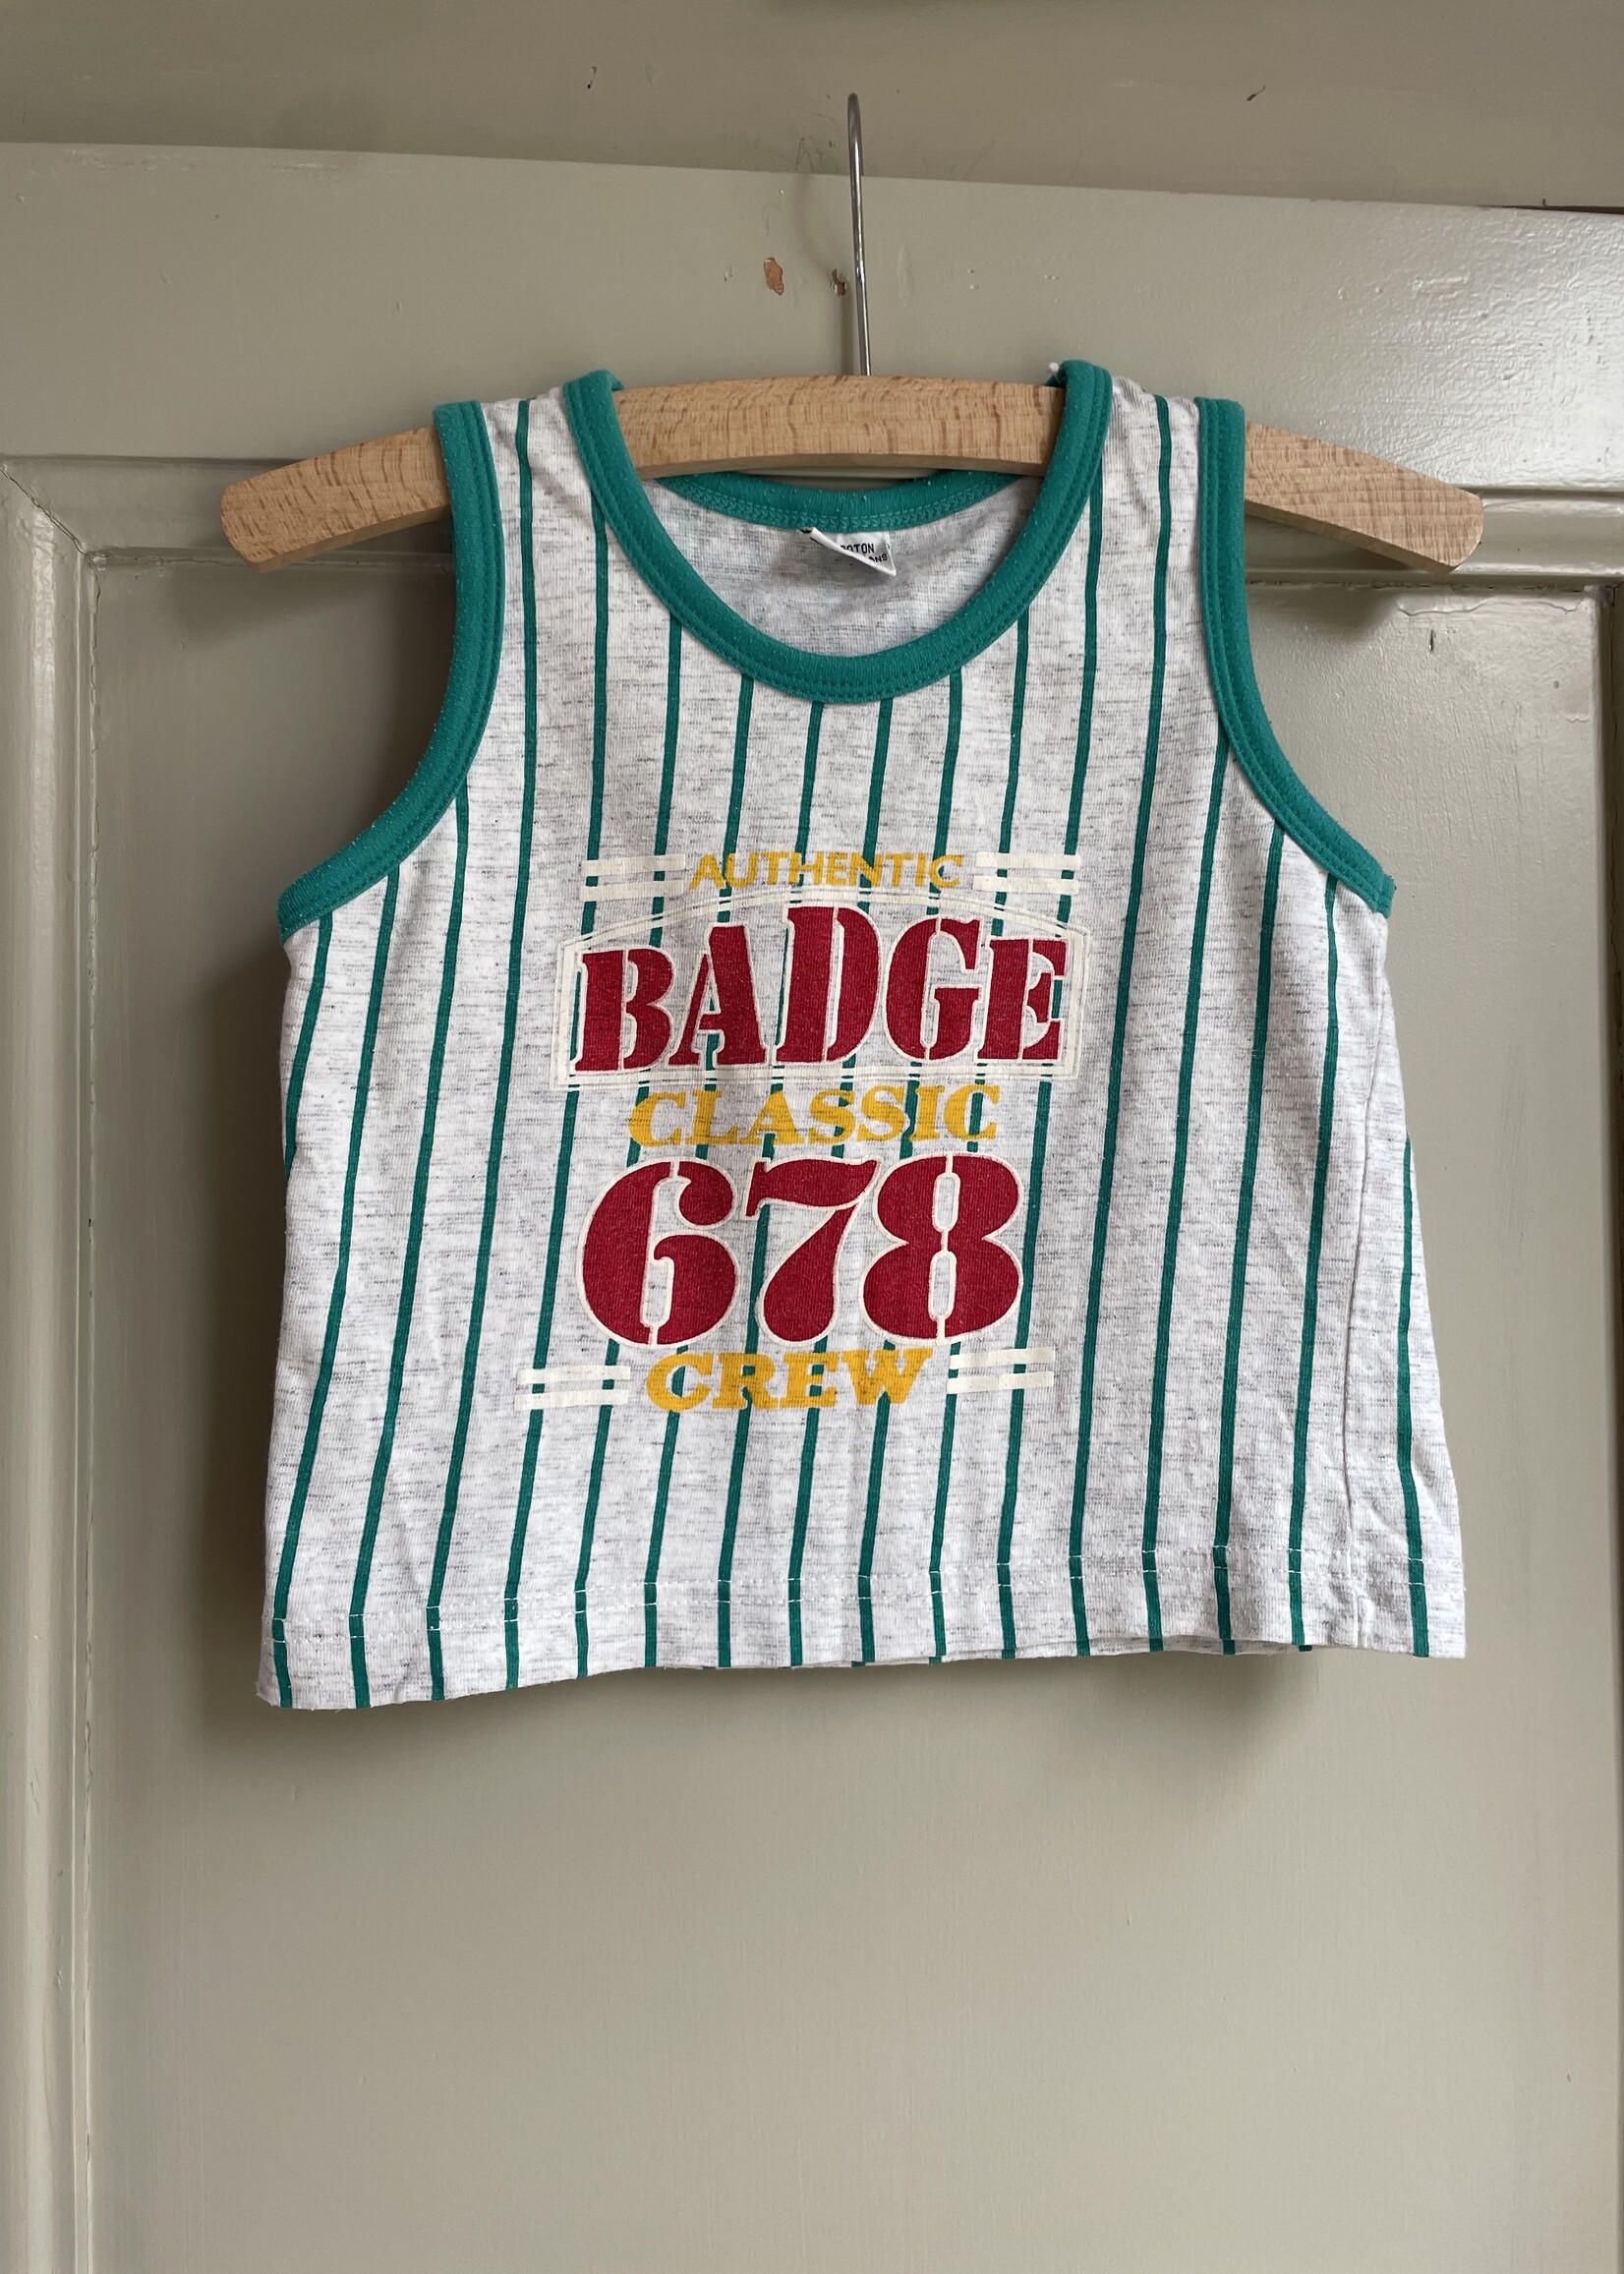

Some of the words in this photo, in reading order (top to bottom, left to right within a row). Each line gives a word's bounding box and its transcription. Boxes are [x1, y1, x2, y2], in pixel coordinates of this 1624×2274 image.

[689, 851, 964, 890] AUTHENTIC
[574, 903, 1070, 1073] BADGE
[627, 1084, 1000, 1146] CLASSIC
[578, 1152, 1023, 1347] 678
[646, 1349, 932, 1411] CREW
